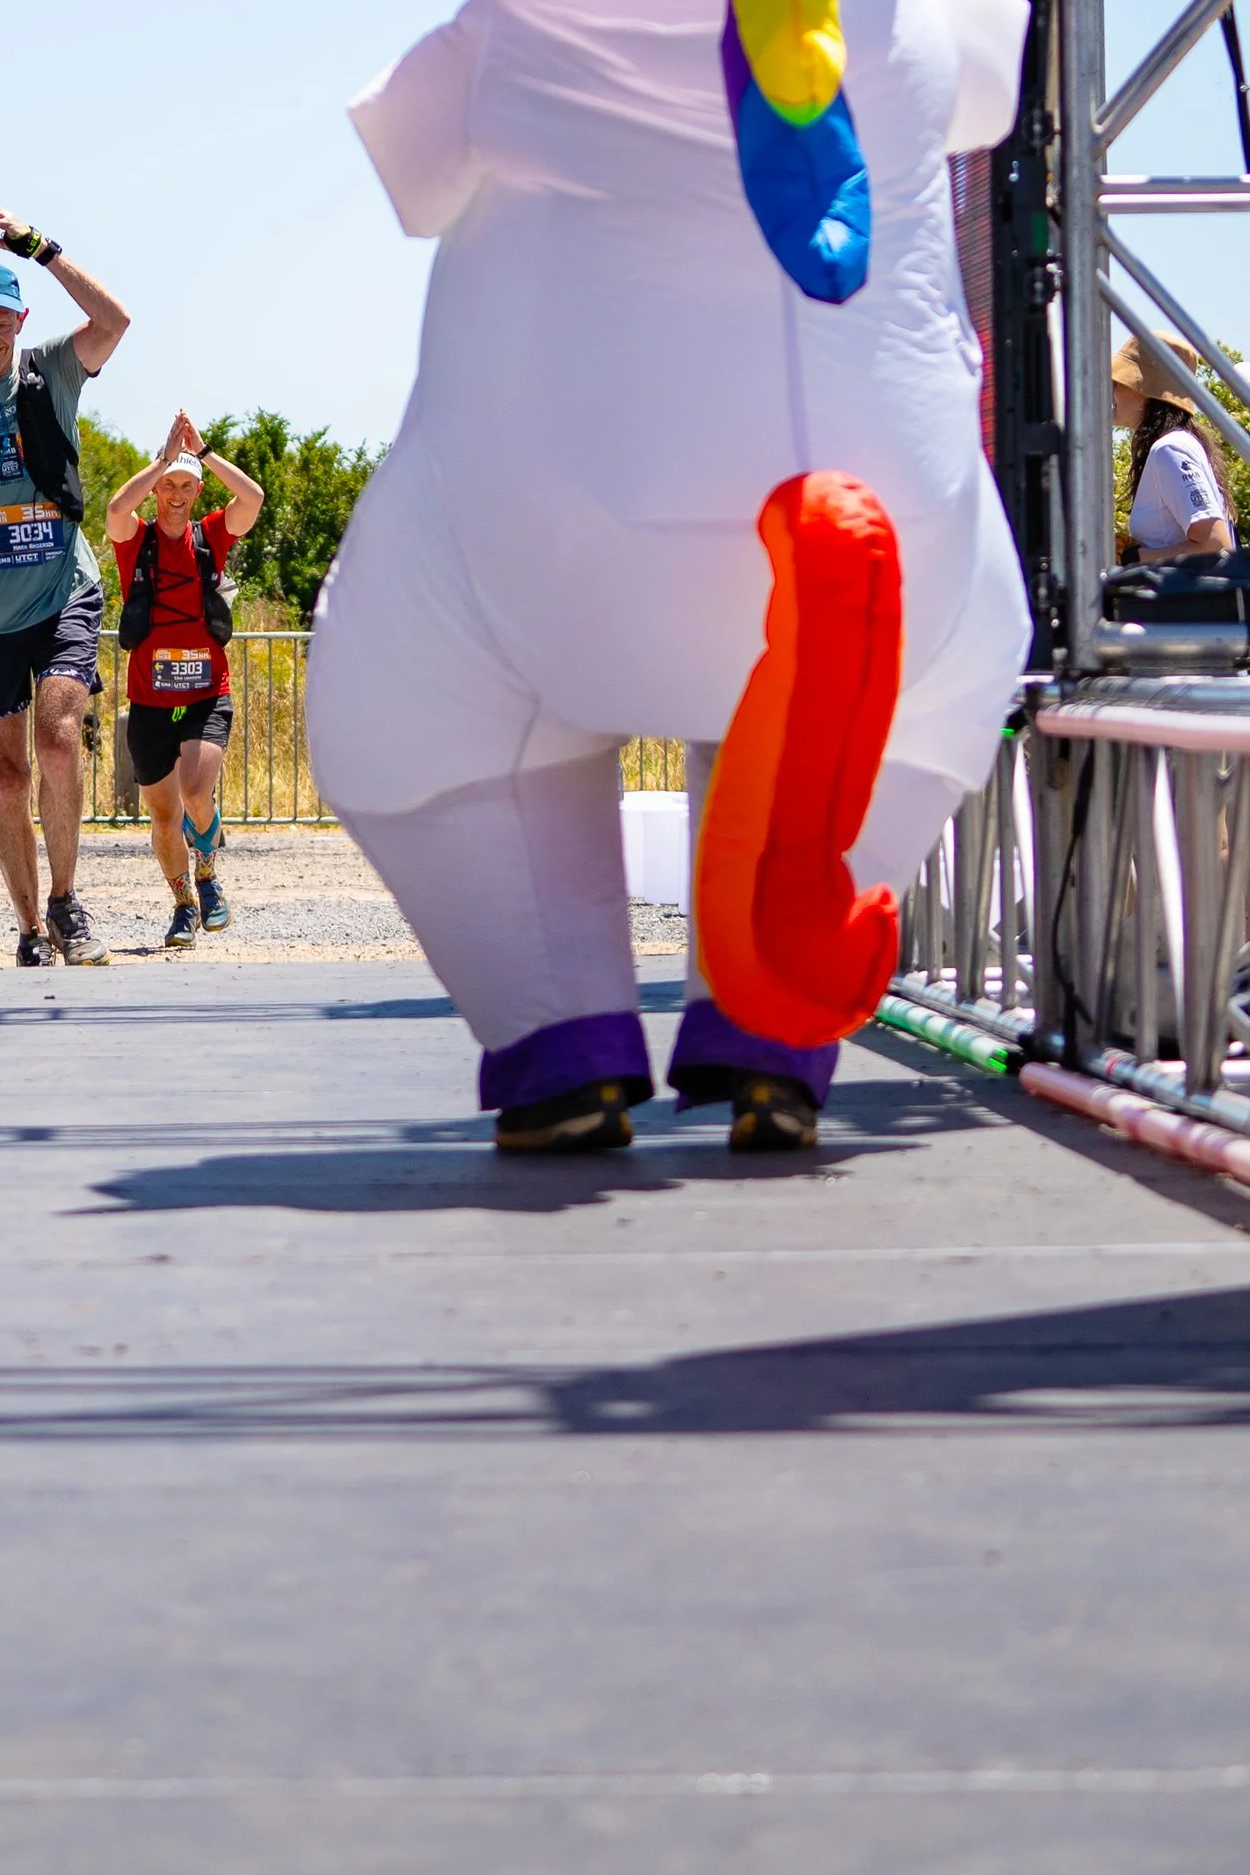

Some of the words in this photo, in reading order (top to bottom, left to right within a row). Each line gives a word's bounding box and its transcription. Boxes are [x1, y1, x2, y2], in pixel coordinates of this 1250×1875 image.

[8, 521, 53, 543] 3034
[15, 552, 39, 561] UTCT
[171, 662, 203, 675] 3303
